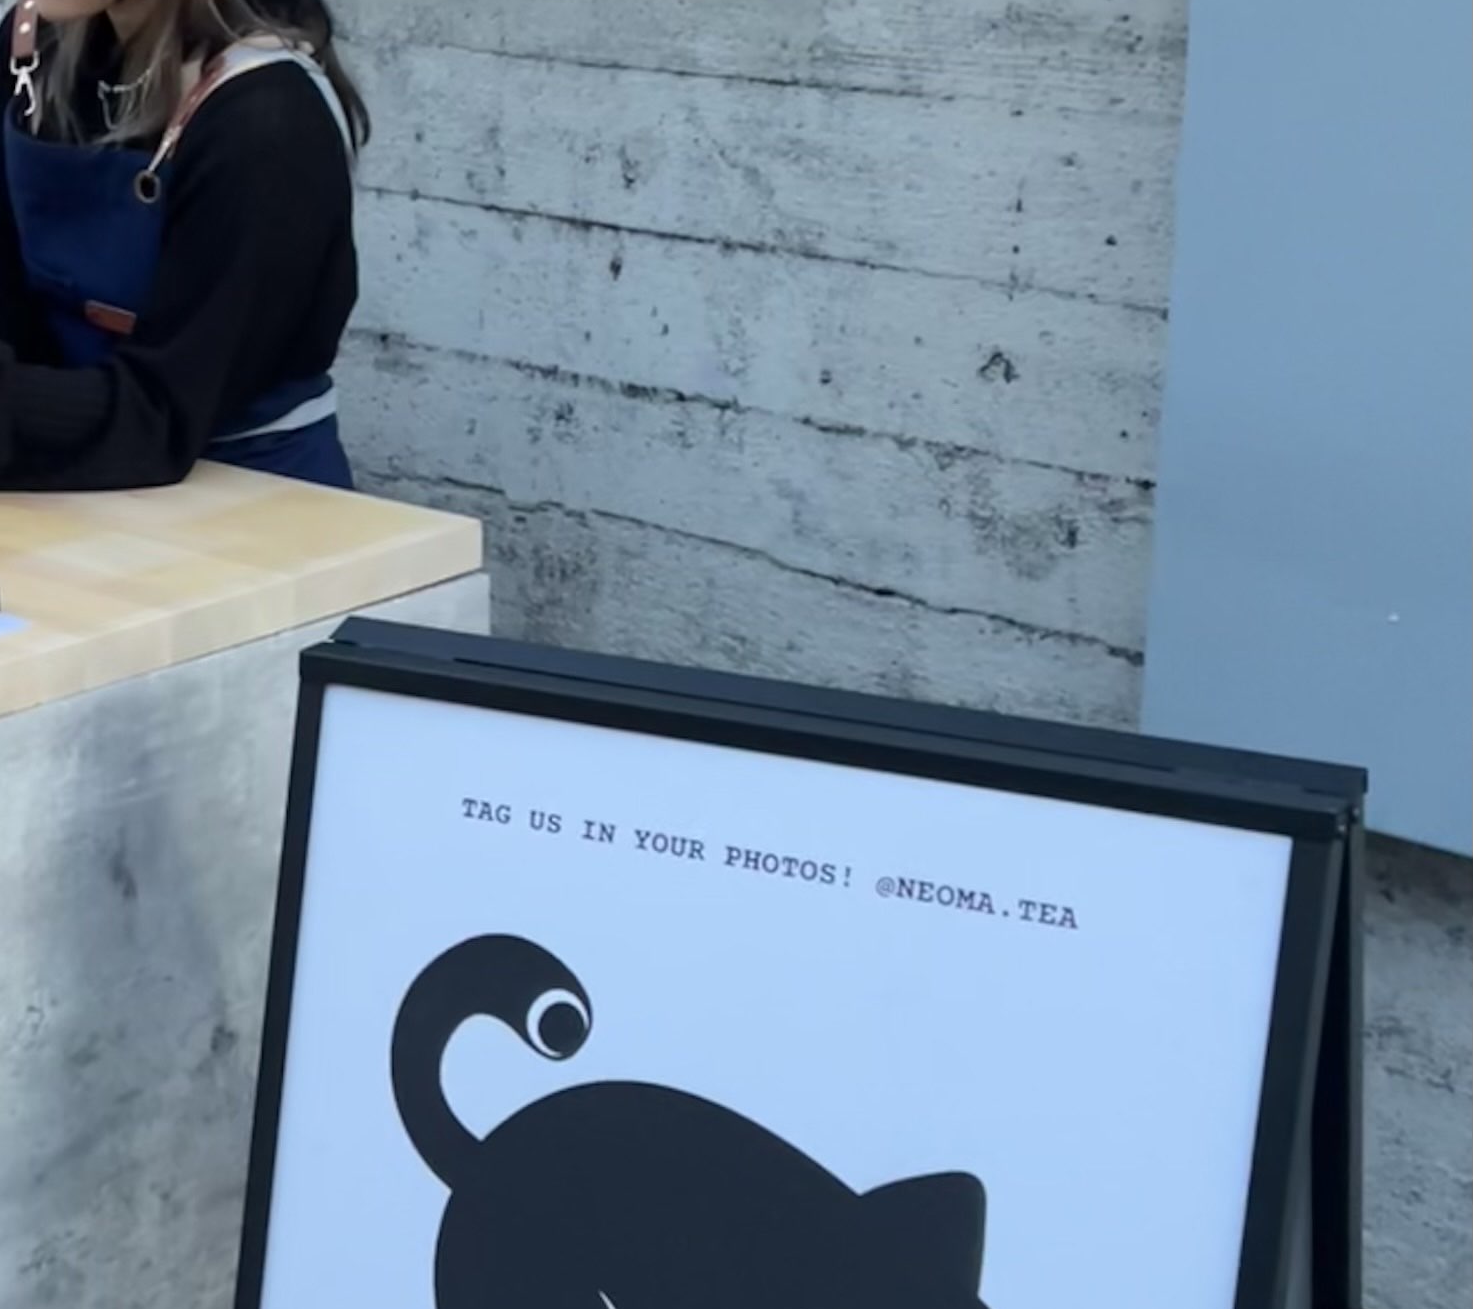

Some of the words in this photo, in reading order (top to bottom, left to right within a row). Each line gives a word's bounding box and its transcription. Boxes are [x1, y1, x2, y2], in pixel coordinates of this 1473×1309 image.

[461, 797, 512, 825] TAG
[529, 809, 562, 834] US
[581, 819, 616, 844] IN
[634, 829, 705, 861] YOUR
[723, 845, 852, 888] PHOTOS!
[875, 876, 1078, 930] @NEOMA.TEA
